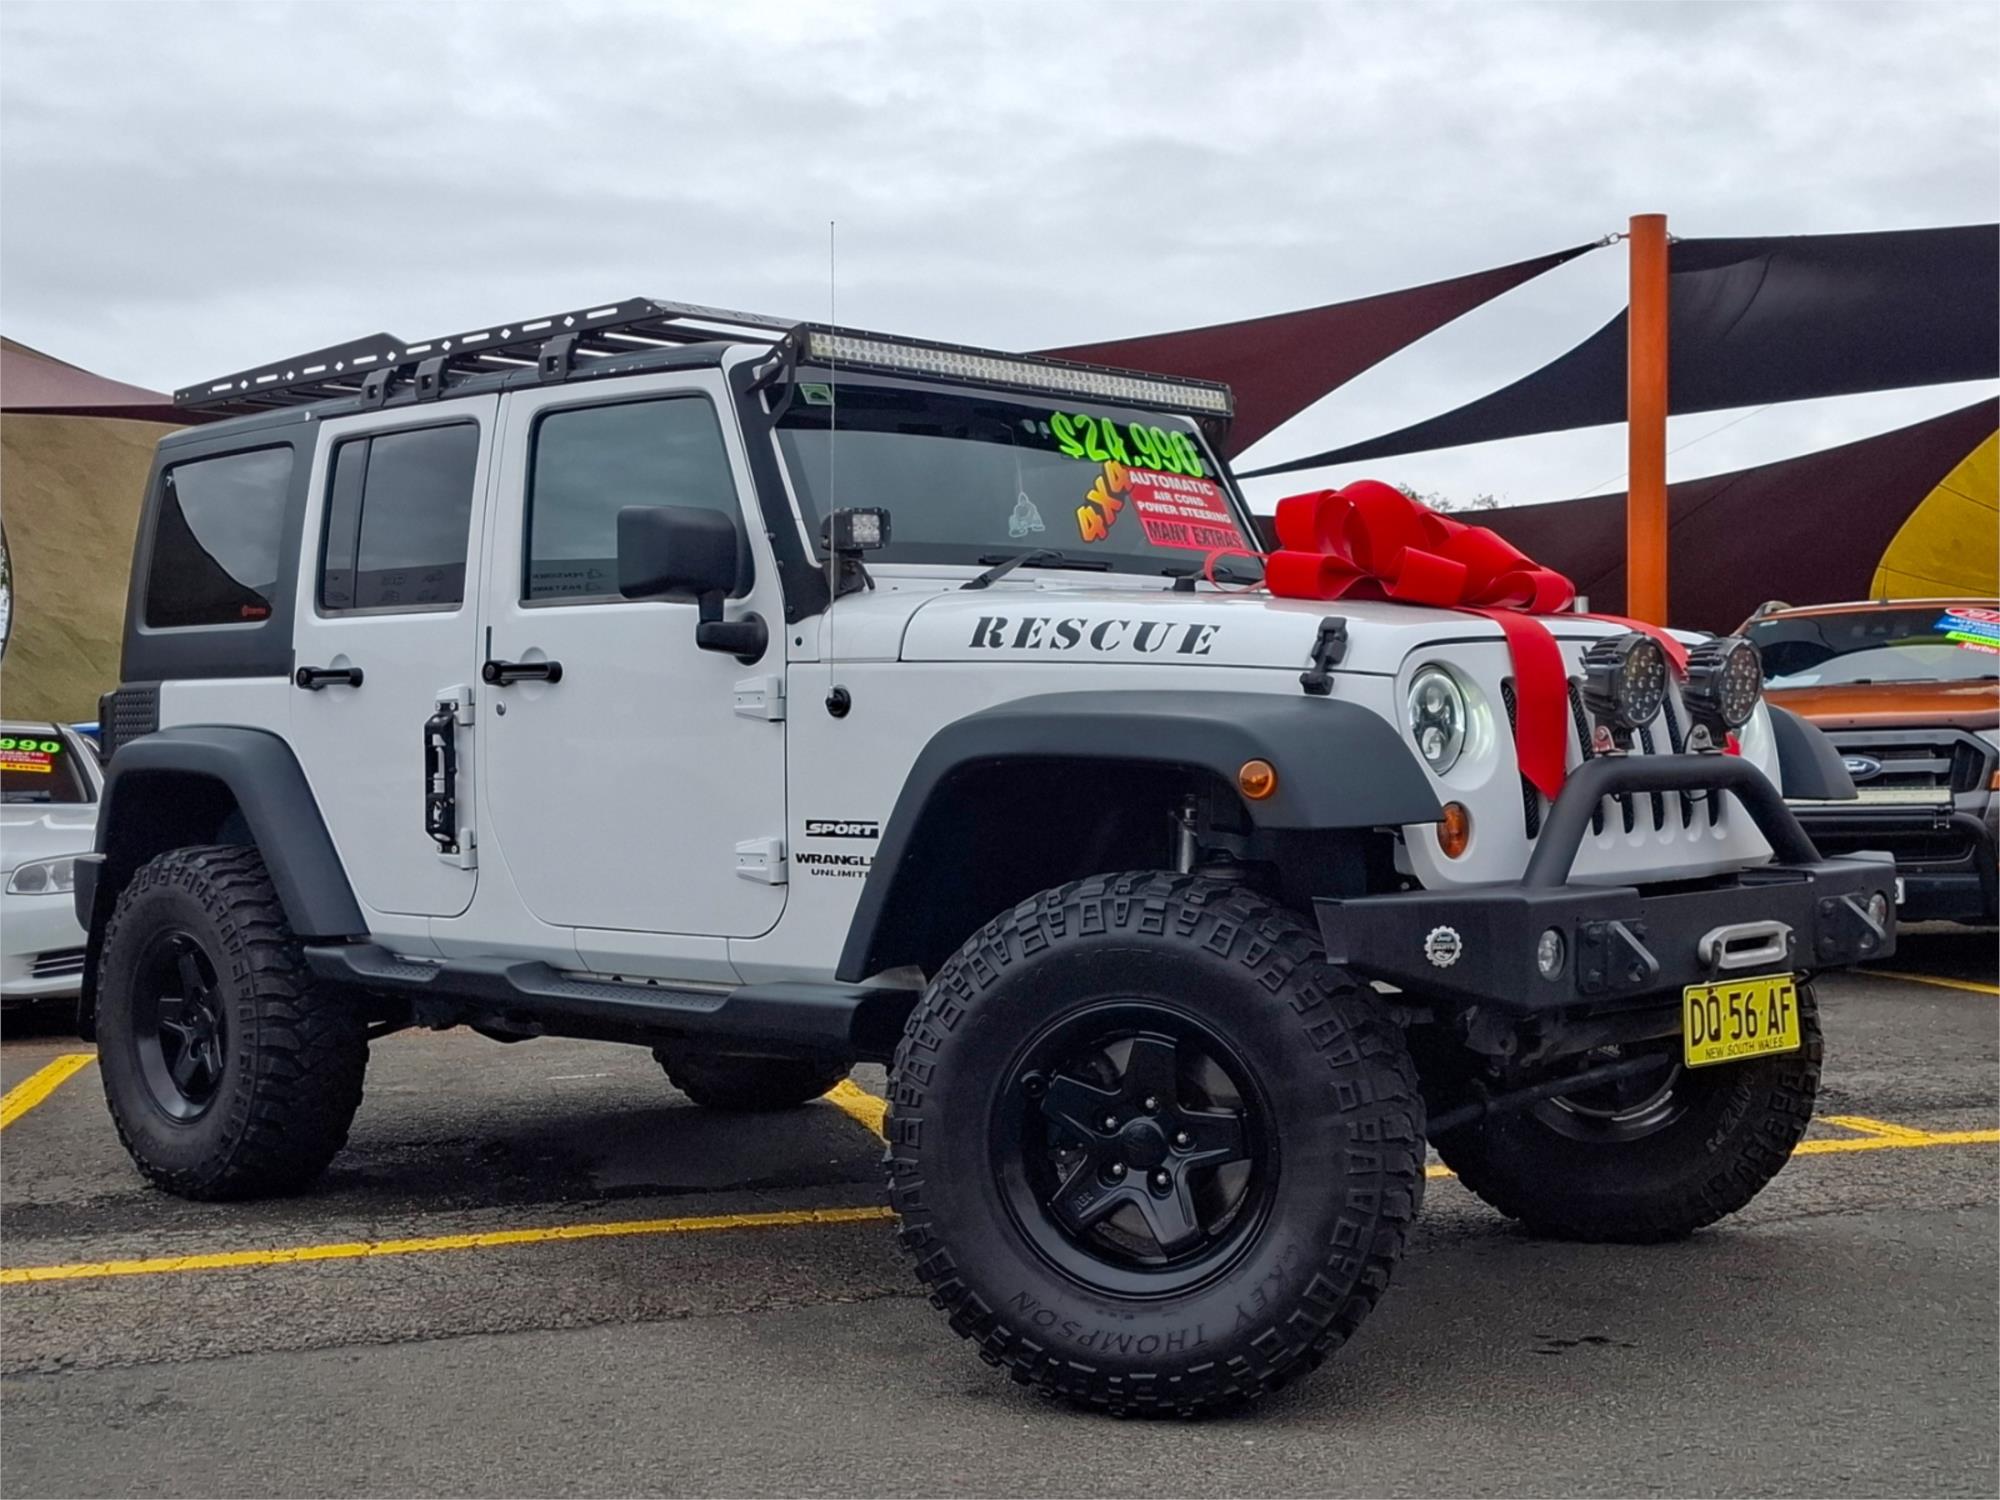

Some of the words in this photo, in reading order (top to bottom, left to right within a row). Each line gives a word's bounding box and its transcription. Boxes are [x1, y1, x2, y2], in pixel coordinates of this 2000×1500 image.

[1129, 471, 1214, 496] AUTOMATIC
[1153, 490, 1173, 502] AIR
[1137, 501, 1178, 515] POWER
[1179, 506, 1232, 523] STEERING
[1147, 520, 1188, 542] MANY
[1191, 525, 1243, 549] EXTRAS
[968, 616, 1222, 655] RESCUE
[807, 821, 878, 837] SPORT
[795, 852, 876, 867] WRANGL
[1705, 1046, 1724, 1059] NEW
[1727, 1042, 1755, 1056] SOUTH
[1759, 1037, 1785, 1051] WALES
[1008, 1290, 1210, 1355] THOMPSON
